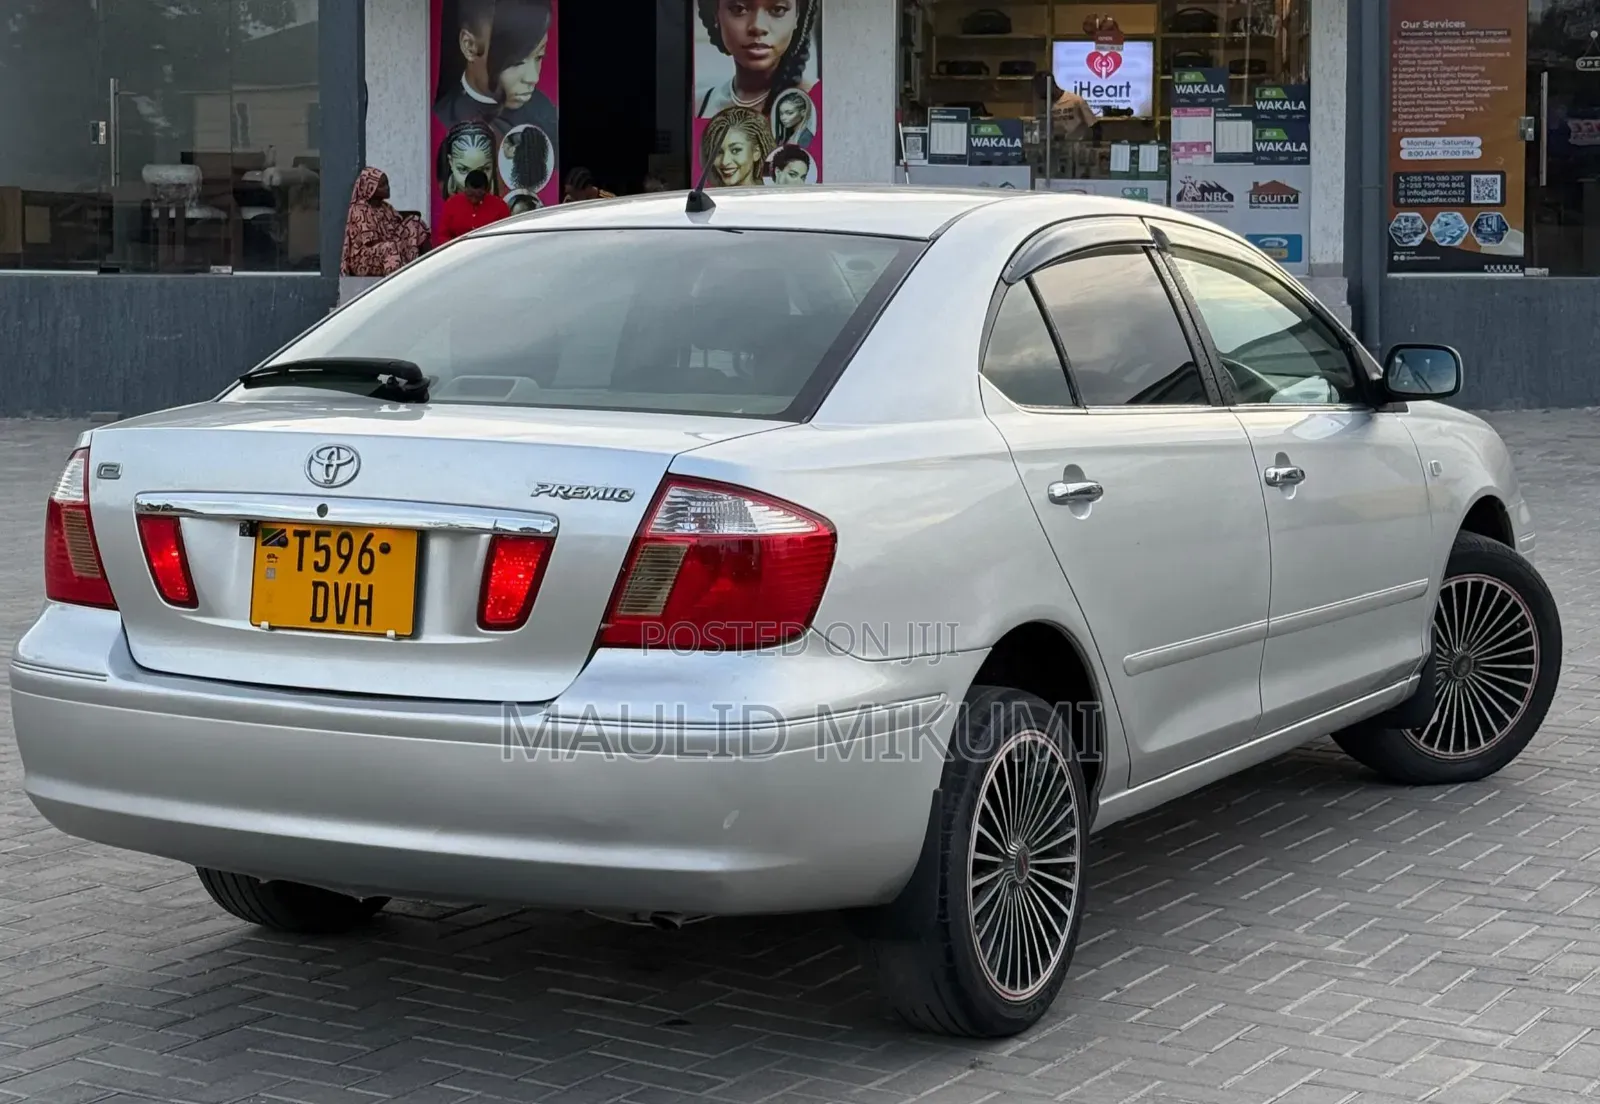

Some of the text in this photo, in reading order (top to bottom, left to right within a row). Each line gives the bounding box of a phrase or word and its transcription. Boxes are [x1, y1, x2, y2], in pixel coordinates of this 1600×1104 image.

[1401, 19, 1466, 29] Our Services
[1578, 59, 1600, 68] OPE
[1074, 80, 1131, 98] iHeart
[1175, 84, 1225, 94] WAKALA
[1255, 101, 1306, 111] WAKALA
[971, 138, 1022, 148] WAKALA
[1255, 142, 1308, 152] WAKALA
[1442, 139, 1475, 147] Saturday
[1204, 192, 1229, 201] NBC
[1406, 189, 1465, 197] info@adfax.co.tz
[1252, 194, 1296, 203] EQUITY
[530, 482, 635, 502] PREMIO
[293, 529, 375, 575] T596
[310, 581, 373, 626] DVH
